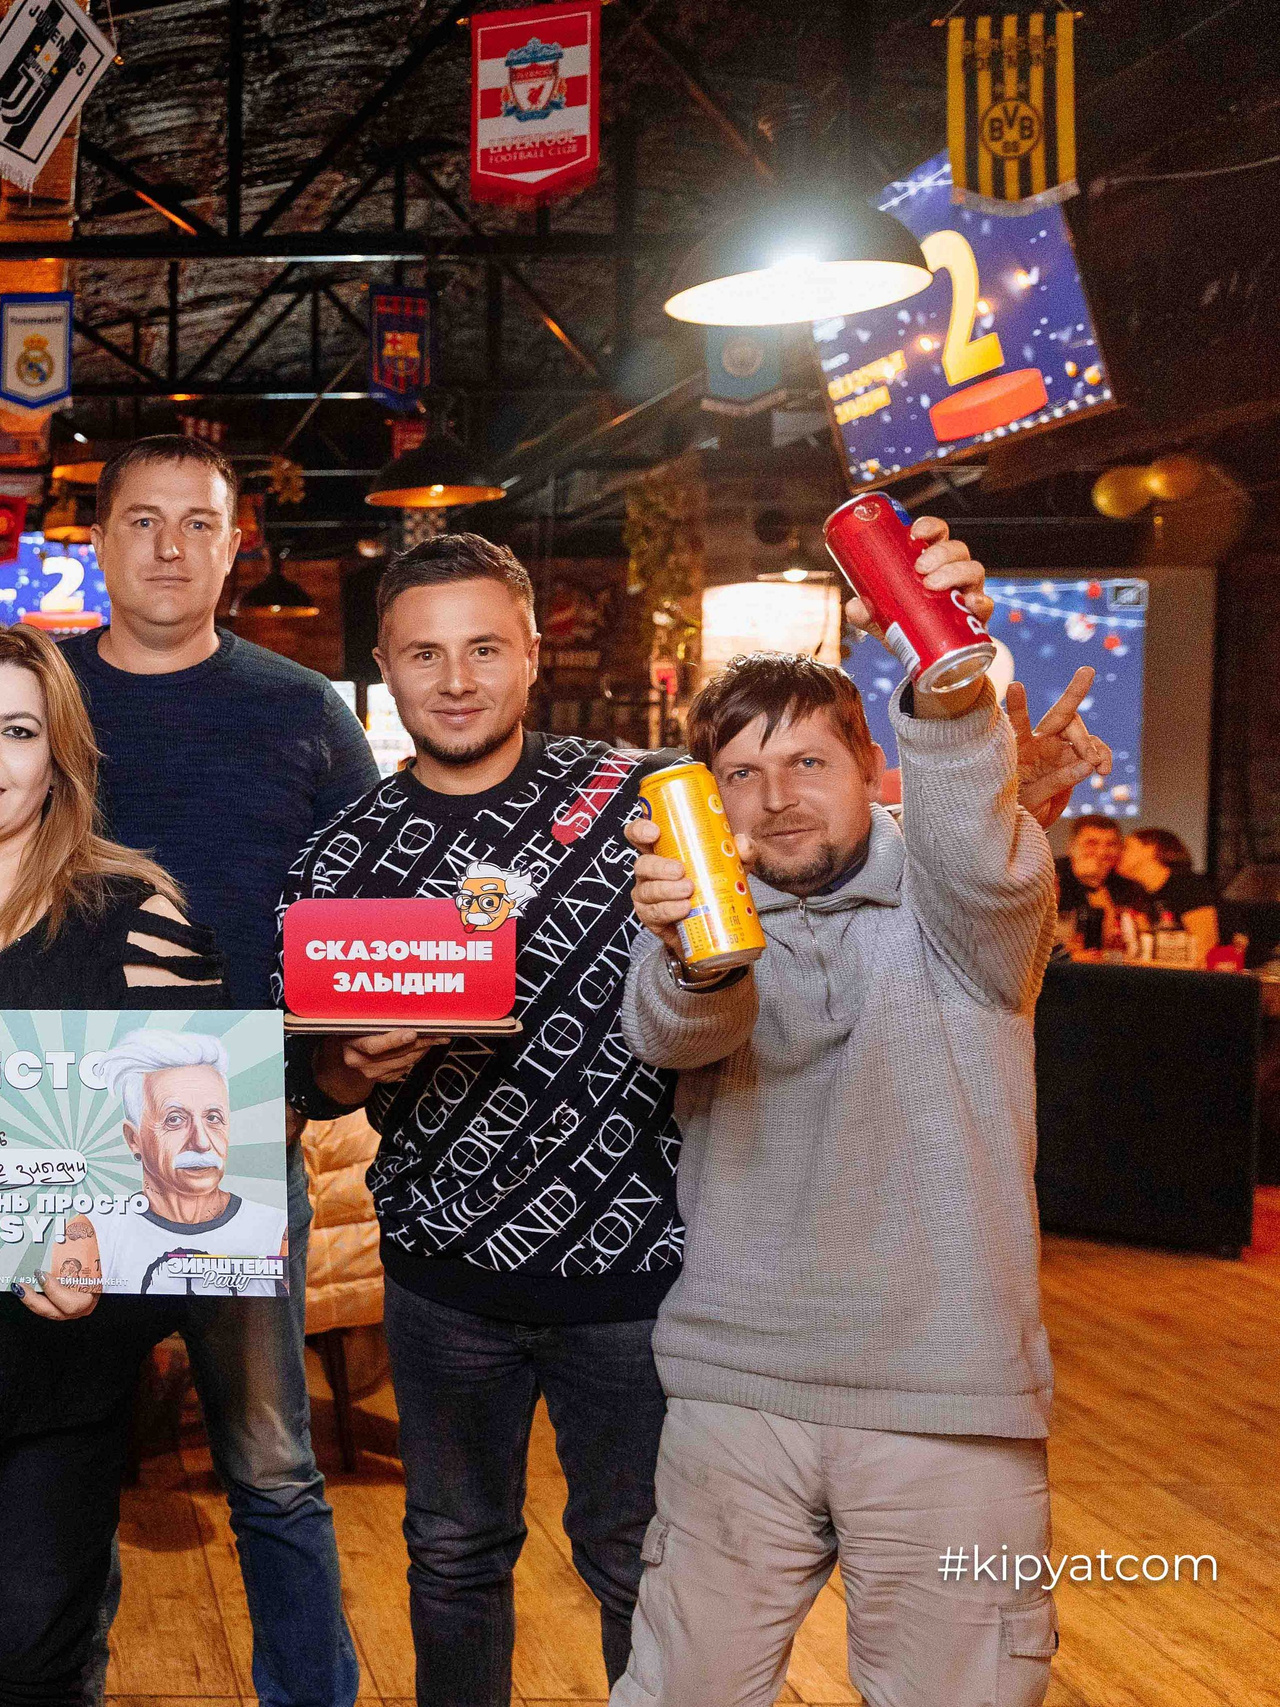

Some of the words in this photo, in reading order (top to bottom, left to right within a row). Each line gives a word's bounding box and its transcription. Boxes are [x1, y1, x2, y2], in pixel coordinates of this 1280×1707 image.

[29, 4, 87, 77] JUVENTUS
[920, 229, 1005, 387] 2
[40, 556, 85, 613] 2
[553, 746, 642, 840] SAW
[374, 811, 439, 886] TO
[305, 939, 493, 961] СКАЗОЧНЫЕ
[333, 971, 465, 994] ЗЛЫДНИ
[513, 1010, 587, 1088] TO
[569, 1112, 637, 1186] TO
[36, 1193, 151, 1215] ПРОСТО
[202, 1270, 251, 1292] Party
